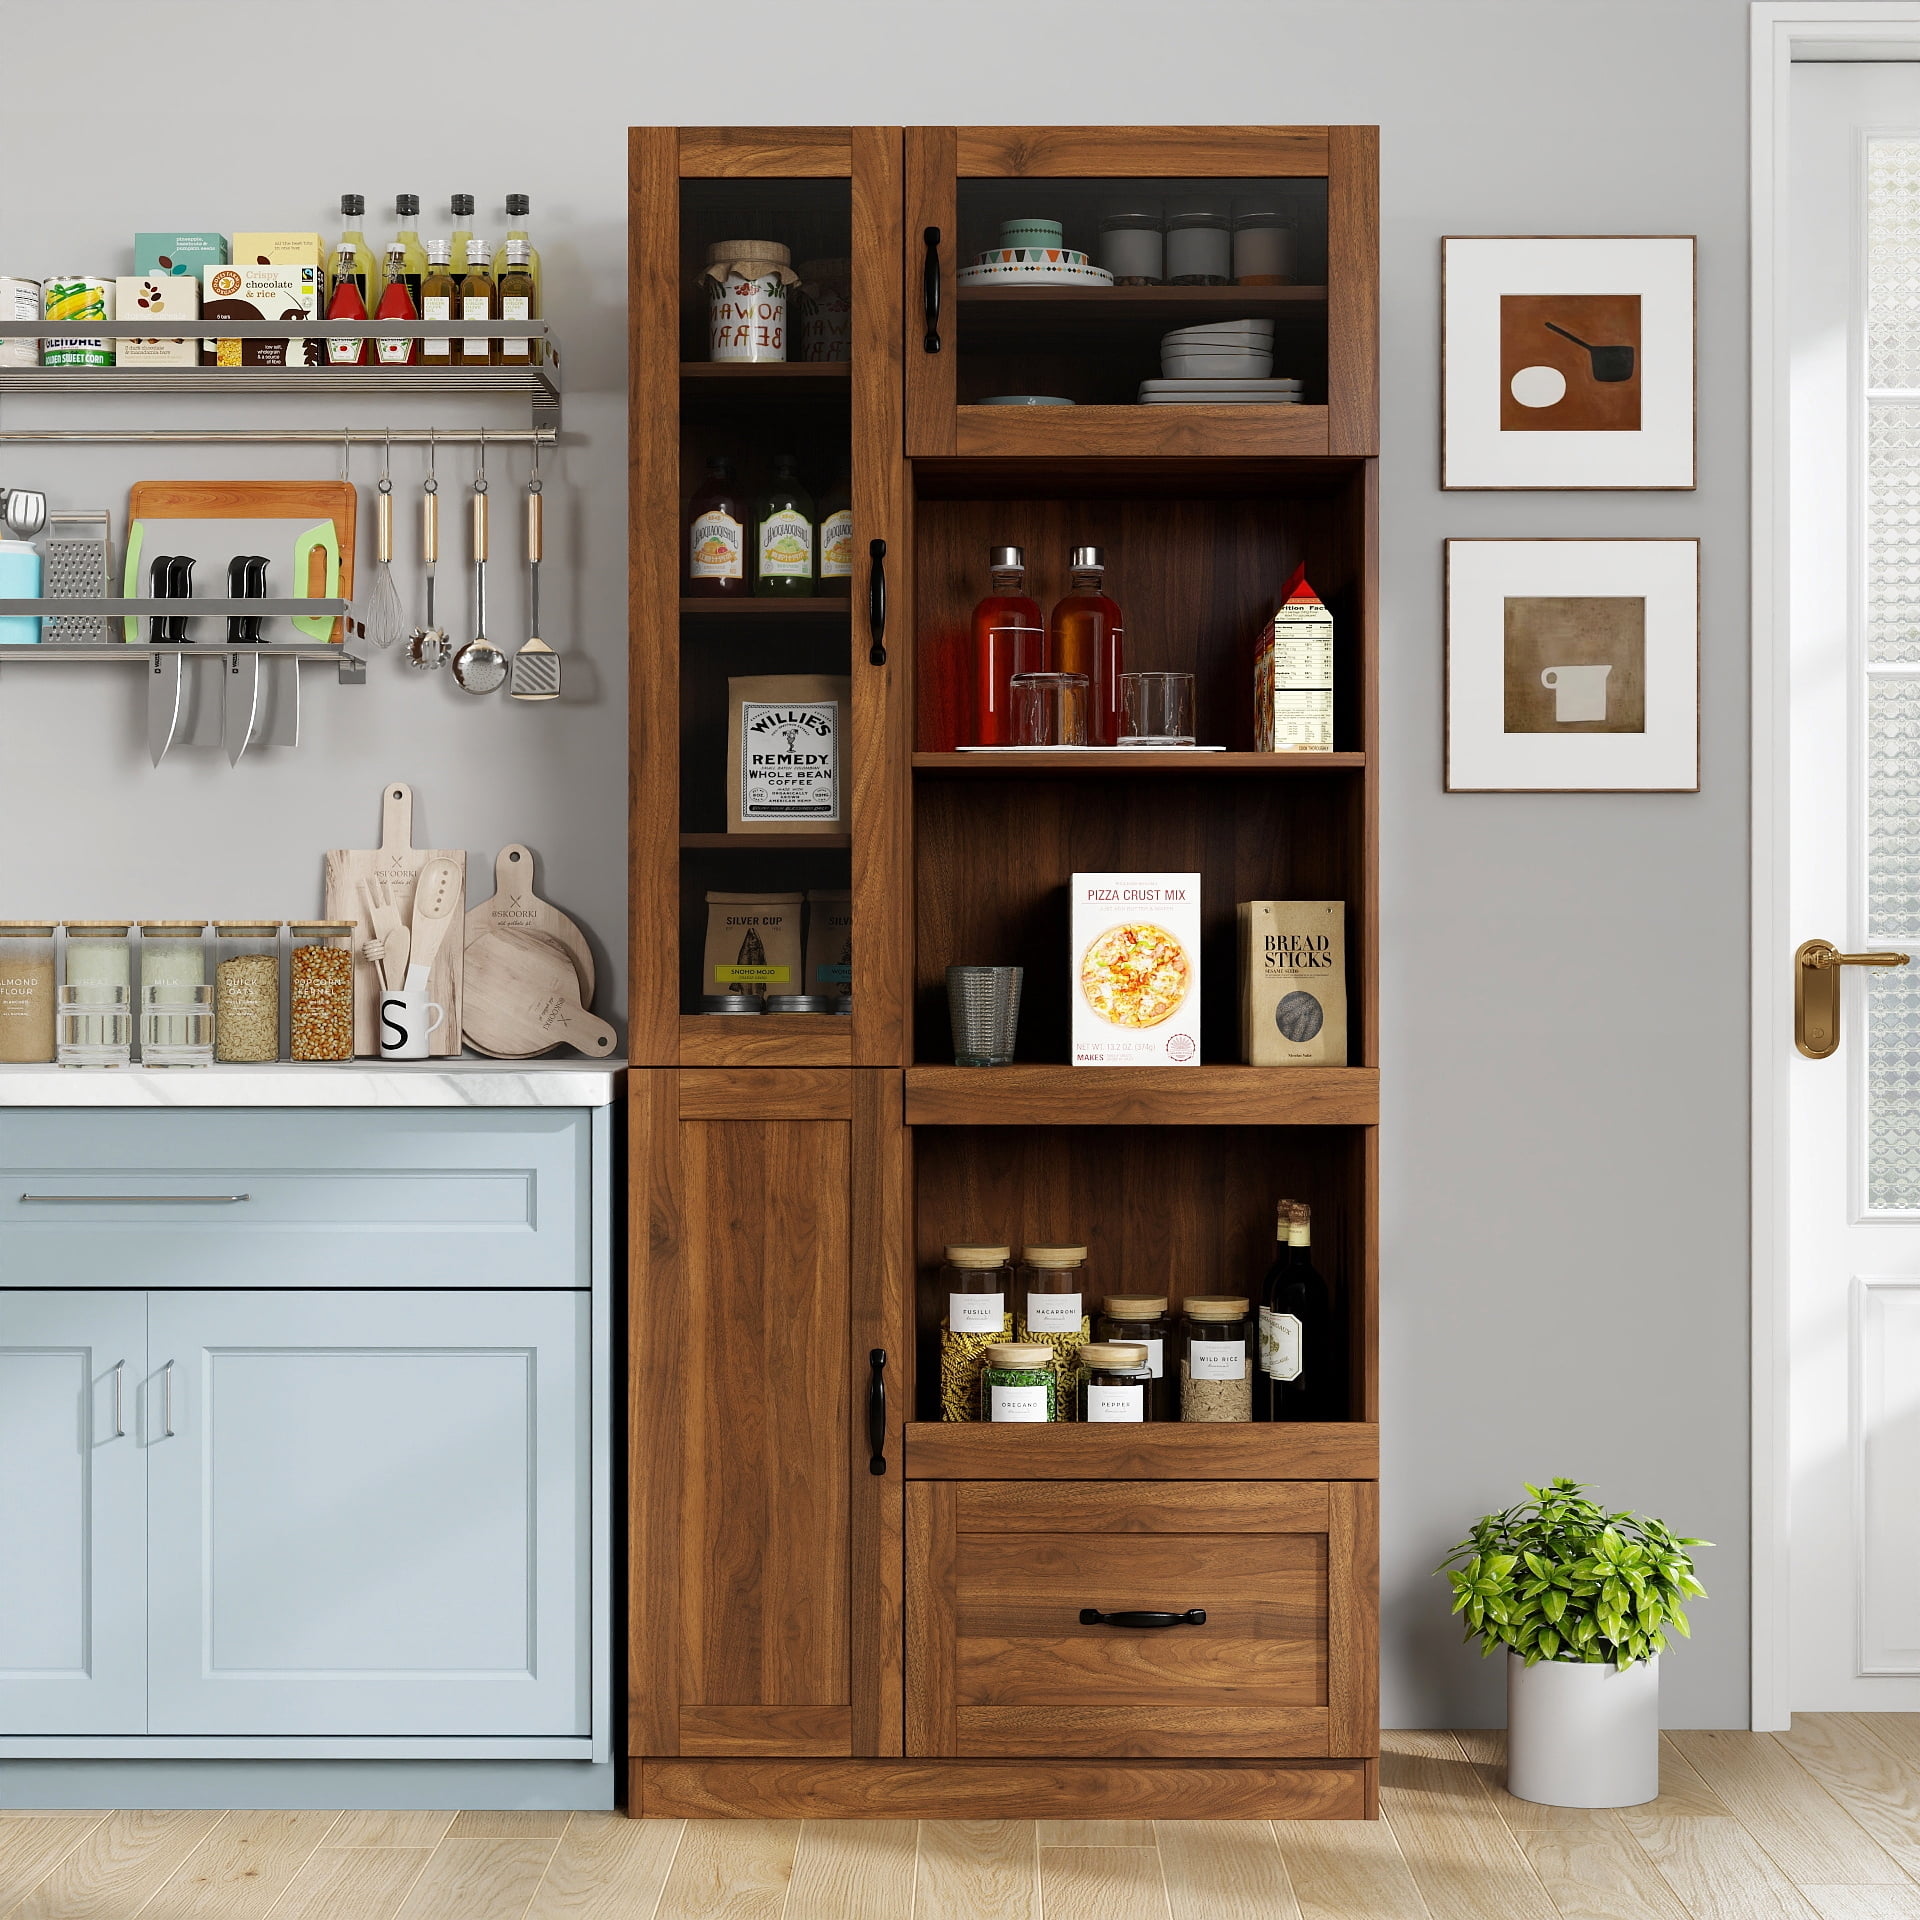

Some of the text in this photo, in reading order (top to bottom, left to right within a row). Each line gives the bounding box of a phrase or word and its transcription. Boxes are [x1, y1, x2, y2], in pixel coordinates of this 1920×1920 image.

[246, 271, 279, 281] Crispy
[246, 280, 293, 289] chocolate
[62, 354, 84, 363] SWEET
[85, 354, 104, 364] CORN
[750, 711, 831, 736] WILLIE'S
[752, 754, 828, 765] REMEDY
[749, 770, 832, 778] WHOLE BEAN
[1088, 890, 1186, 900] PIZZA CRUST MIX
[726, 917, 782, 925] SILVER CUP
[828, 917, 850, 925] SILV
[1264, 935, 1329, 951] BREAD
[1265, 952, 1332, 968] STICKS
[382, 1000, 408, 1050] S
